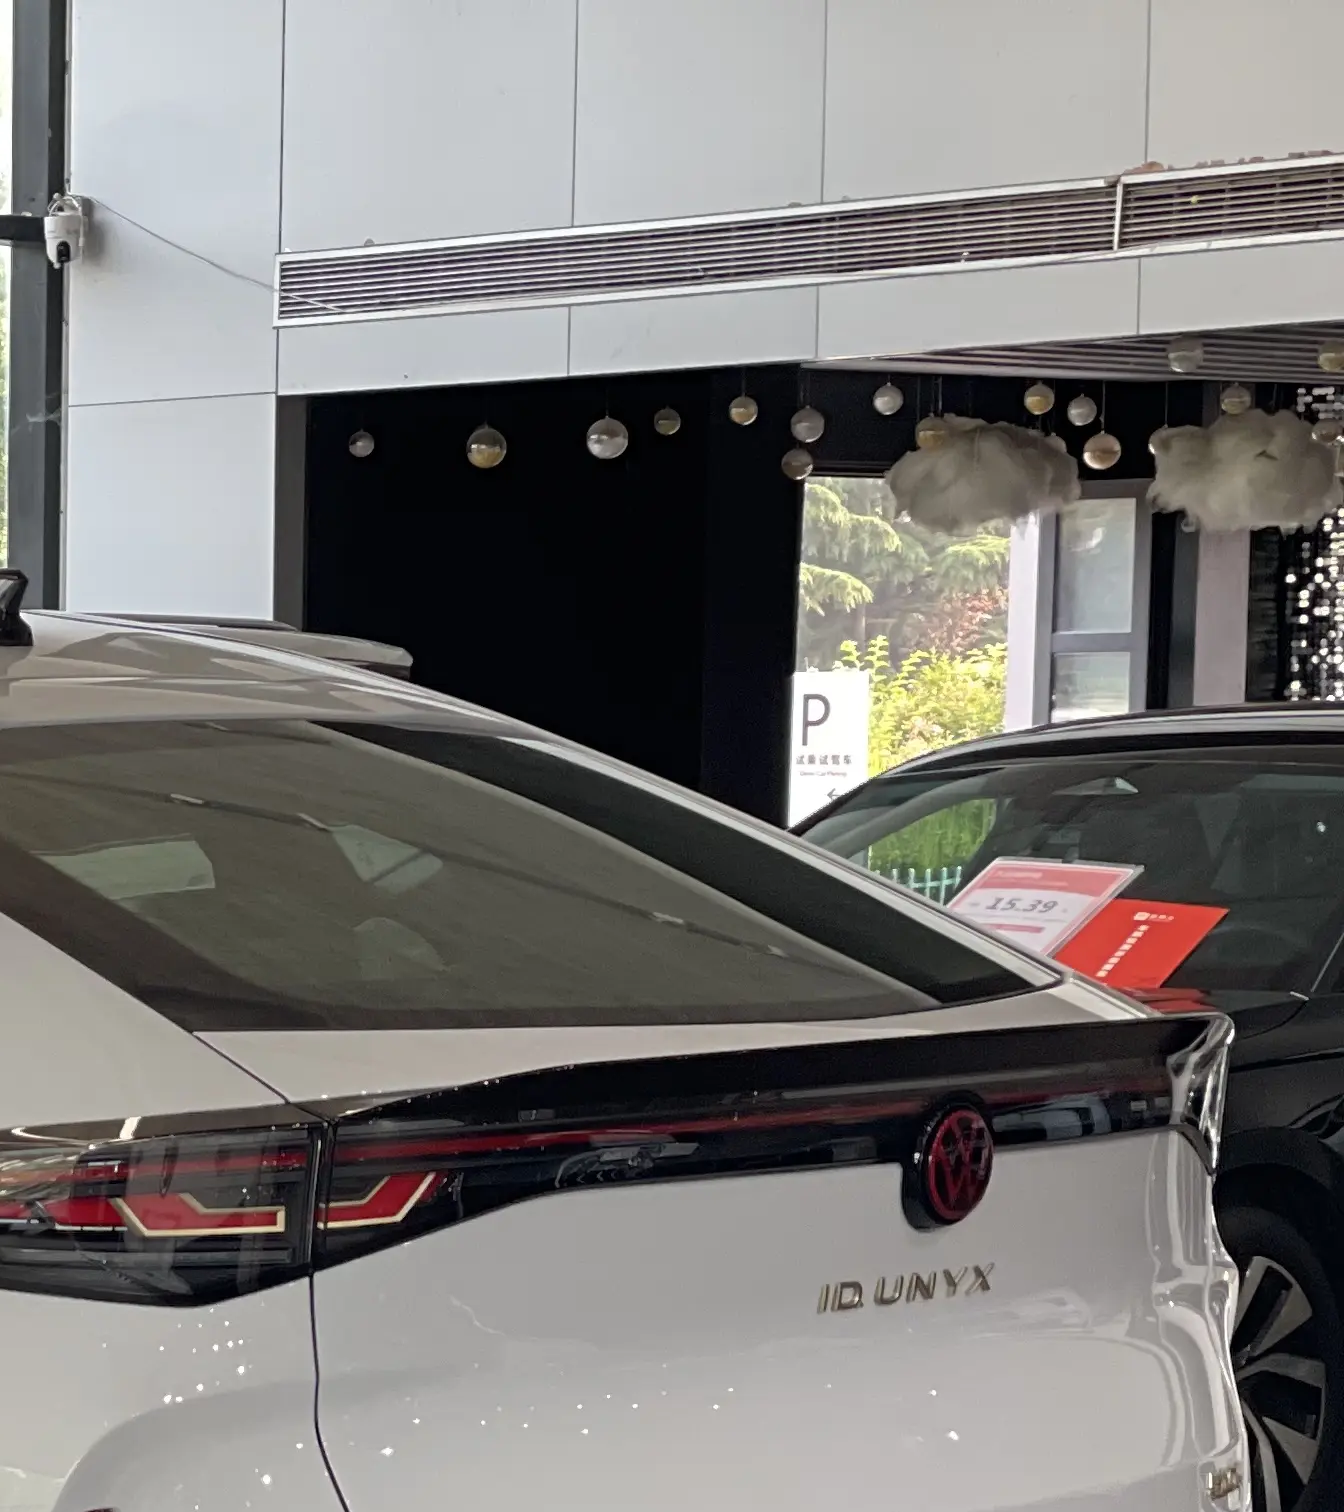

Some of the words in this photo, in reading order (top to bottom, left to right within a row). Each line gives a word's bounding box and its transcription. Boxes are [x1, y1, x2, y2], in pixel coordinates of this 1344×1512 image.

[802, 693, 831, 746] P
[985, 897, 1059, 913] 15.39
[874, 1262, 996, 1307] UNYX
